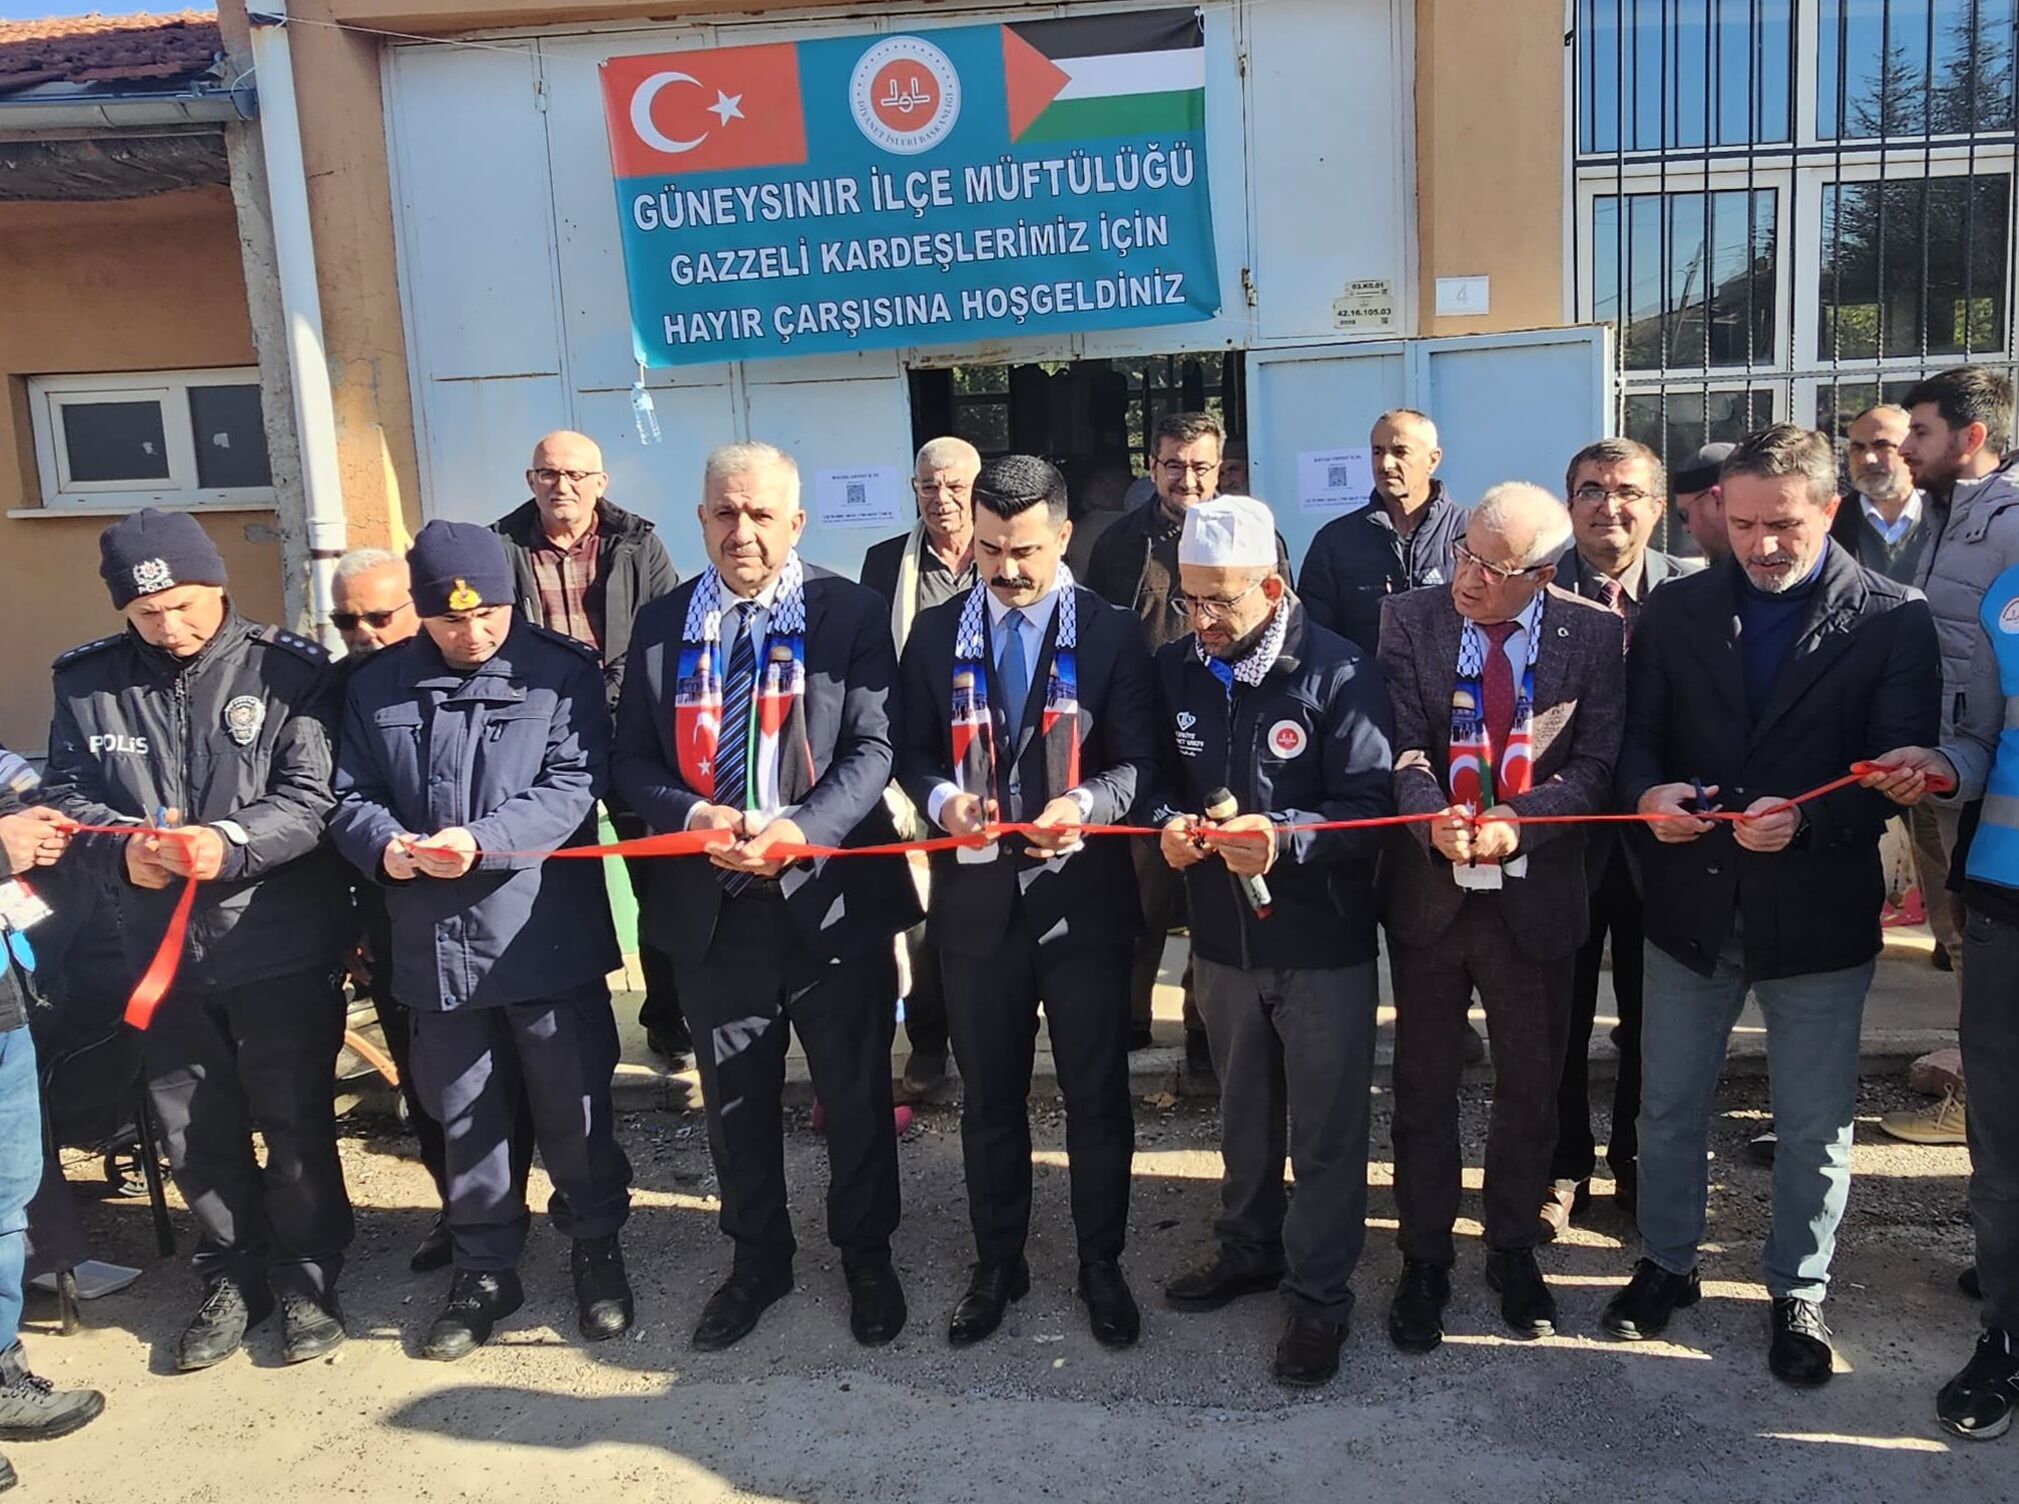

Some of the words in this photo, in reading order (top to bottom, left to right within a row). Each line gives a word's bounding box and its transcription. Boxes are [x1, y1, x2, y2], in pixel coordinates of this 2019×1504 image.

[633, 183, 861, 232] GÜNEYSINIR
[870, 165, 954, 218] İLÇE
[964, 141, 1195, 204] MÜFTÜLÜĞÜ
[670, 237, 810, 286] GAZZELİ
[820, 216, 1090, 274] KARDEŞLERİMİZ
[1100, 209, 1169, 257] İÇİN
[663, 307, 765, 345] HAYIR
[773, 292, 952, 344] ÇARŞISINA
[961, 267, 1186, 324] HOŞGELDİNİZ
[1455, 283, 1470, 305] 4
